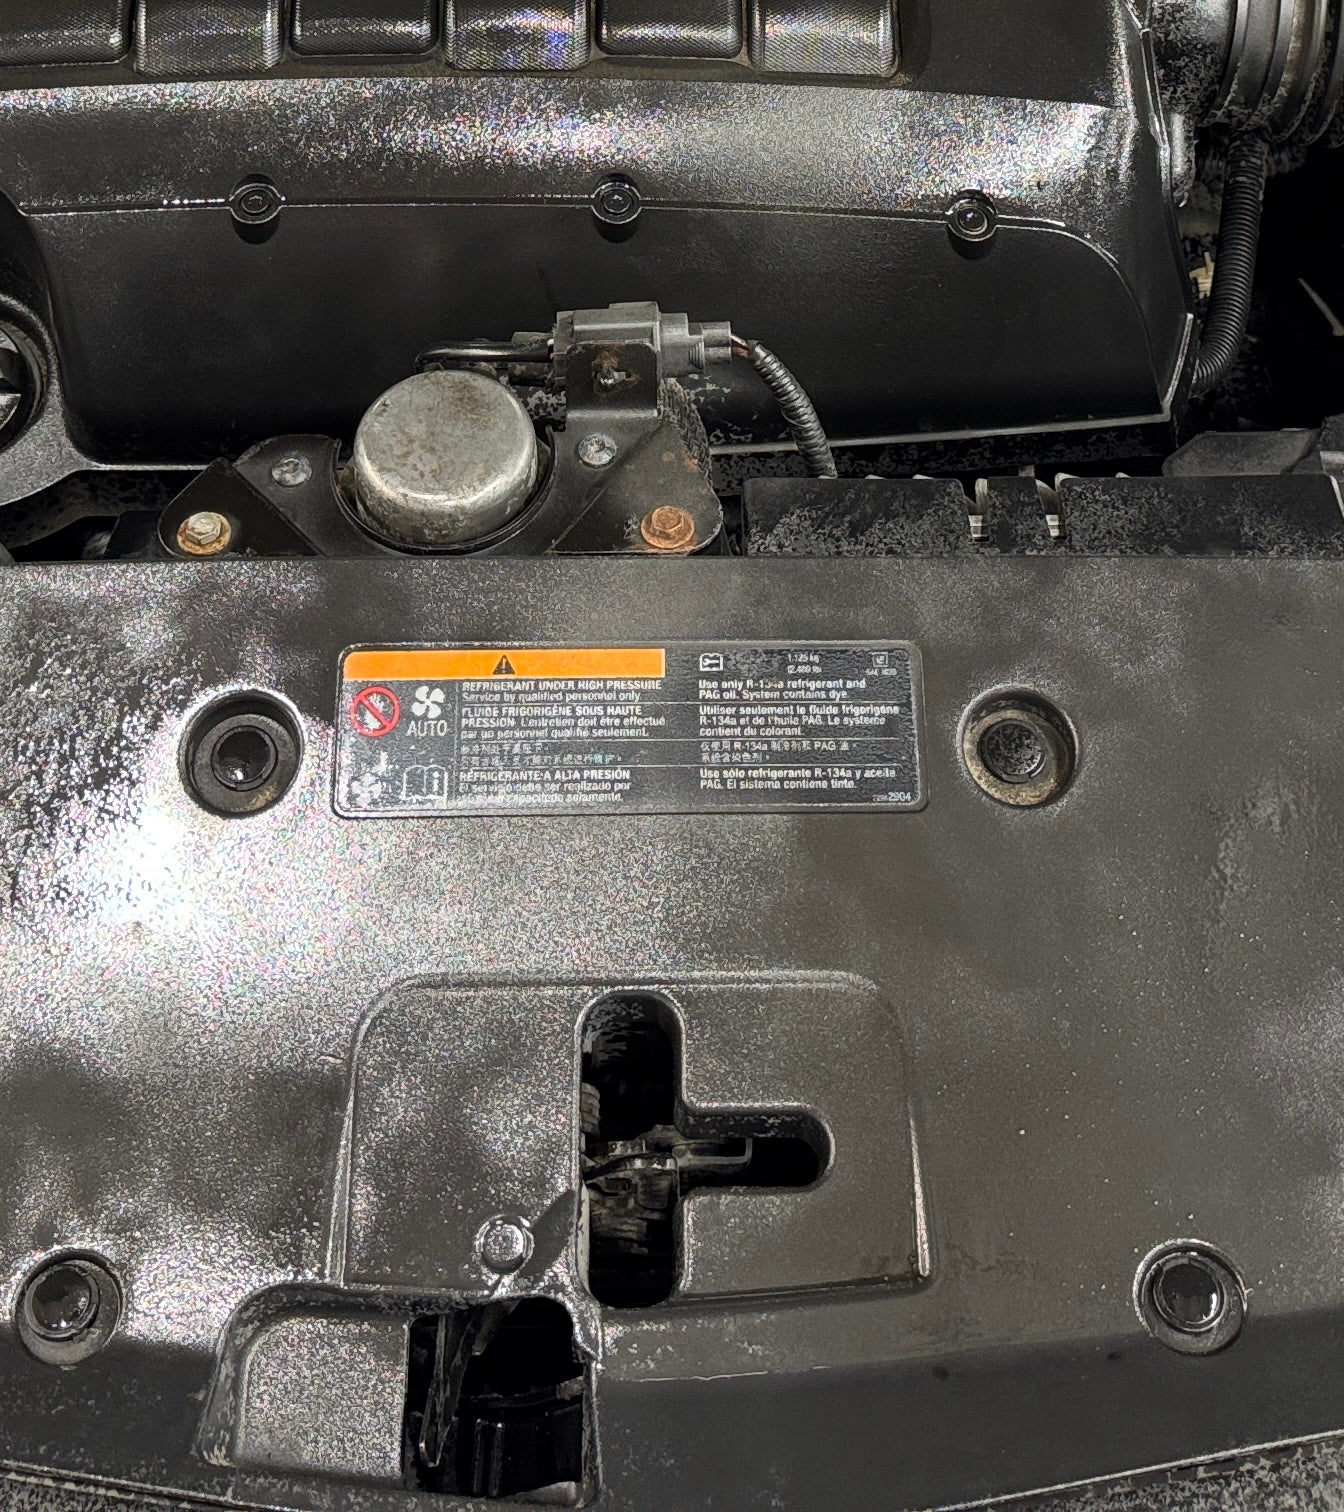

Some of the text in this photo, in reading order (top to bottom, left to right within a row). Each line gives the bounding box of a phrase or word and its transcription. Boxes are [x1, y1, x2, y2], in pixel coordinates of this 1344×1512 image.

[462, 680, 662, 692] REFRIGERANT UNDER HIGH PRESSURE
[699, 679, 718, 689] Use
[721, 679, 743, 691] only
[787, 678, 843, 691] refrigerant
[845, 677, 866, 689] and
[462, 691, 501, 702] Service
[503, 691, 516, 704] by
[518, 691, 563, 704] qualified
[566, 691, 616, 703] personnel
[699, 690, 720, 700] PAG
[742, 689, 780, 701] System
[782, 689, 826, 700] contains
[462, 706, 499, 717] FLUIDE
[575, 705, 604, 716] SOUS
[606, 705, 642, 715] HAUTE
[699, 705, 736, 715] Utiliser
[739, 704, 794, 714] seulement
[796, 704, 806, 714] le
[809, 704, 839, 714] fluide
[578, 716, 597, 726] doit
[699, 716, 737, 725] R-134a
[739, 716, 750, 725] et
[752, 715, 765, 725] de
[827, 716, 840, 725] Le
[406, 719, 448, 737] AUTO
[699, 726, 741, 736] contient
[744, 726, 757, 736] du
[461, 729, 478, 741] par
[733, 741, 768, 751] R-134a
[813, 741, 836, 751] PAG
[543, 770, 551, 781] A
[554, 769, 581, 780] ALTA
[583, 766, 630, 780] PRESIÓN
[700, 768, 719, 778] Use
[748, 768, 811, 781] refrigerante
[814, 768, 852, 778] R-134a
[854, 770, 861, 781] y
[563, 781, 611, 792] realizado
[613, 783, 632, 794] por
[726, 779, 737, 789] El
[740, 779, 781, 789] sistema
[783, 778, 828, 789] contiene
